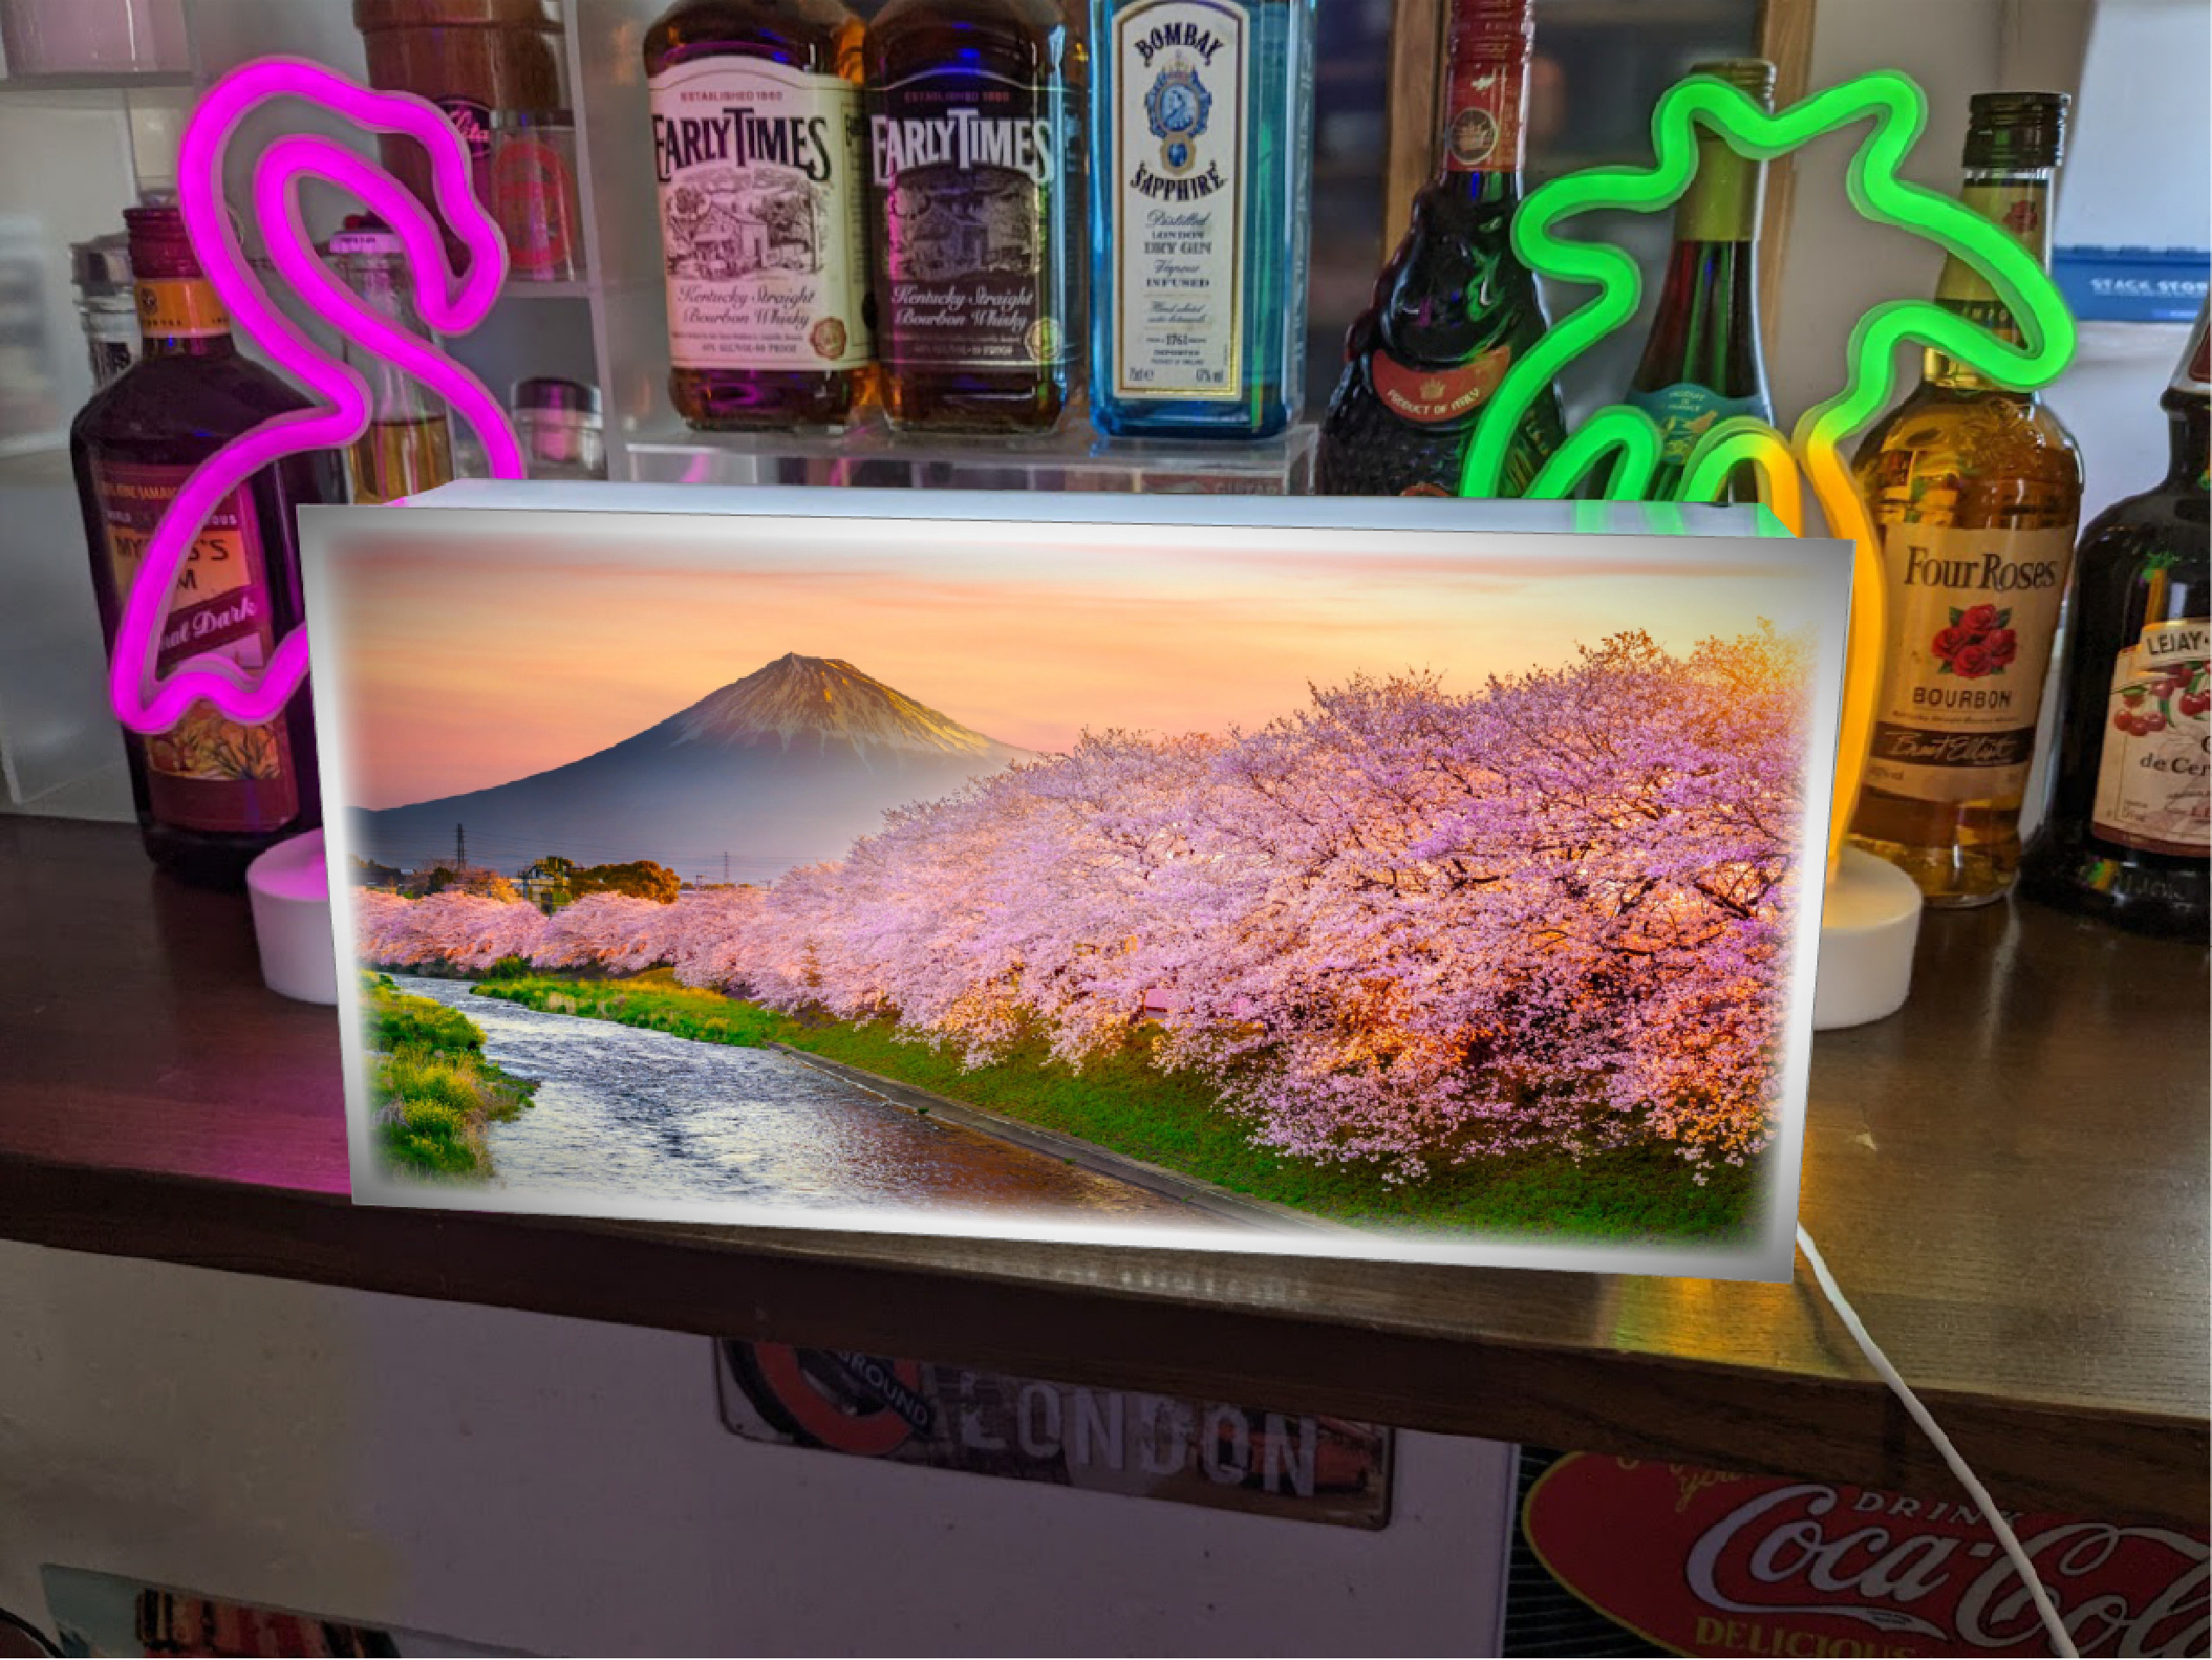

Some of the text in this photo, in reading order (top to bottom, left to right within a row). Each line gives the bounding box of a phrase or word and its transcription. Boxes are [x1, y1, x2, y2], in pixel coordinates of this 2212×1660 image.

[1134, 22, 1225, 68] BOMBAY
[1130, 160, 1228, 202] SAPPHIRE
[1387, 389, 1432, 416] PRODUCT
[1434, 404, 1448, 415] OF
[115, 535, 229, 562] MYS'S
[1904, 545, 2058, 591] Four Roses
[192, 595, 256, 639] Dark
[1912, 687, 2012, 709] BOURBON
[958, 1372, 1317, 1498] LONDON
